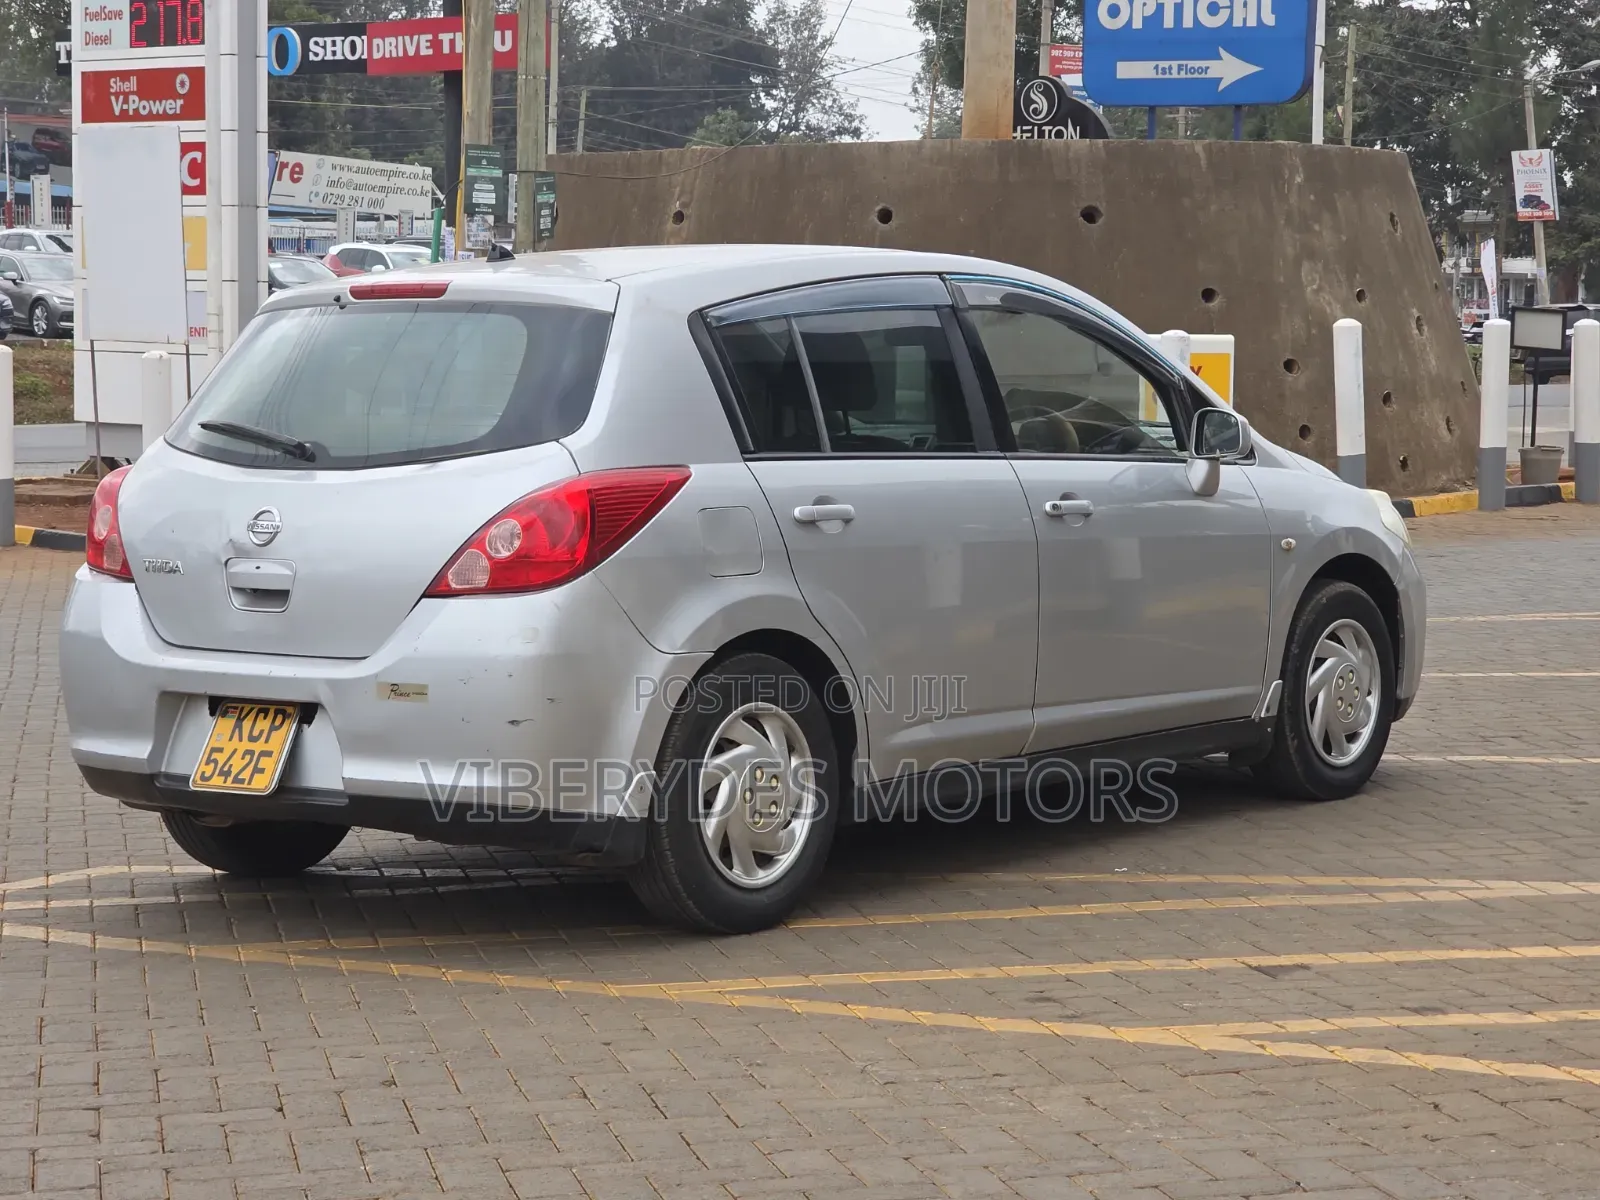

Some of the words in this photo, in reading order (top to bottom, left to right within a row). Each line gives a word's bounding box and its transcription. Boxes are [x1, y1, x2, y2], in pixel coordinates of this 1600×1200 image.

[84, 8, 123, 22] FuelSave
[1097, 0, 1276, 30] OPTICAL
[84, 30, 112, 46] Diesel
[372, 35, 432, 59] DRIVE
[438, 30, 513, 54] TU
[1153, 64, 1173, 76] 1st
[1177, 63, 1210, 75] Floor
[110, 76, 137, 92] Shell
[111, 95, 184, 116] V-Power
[331, 162, 432, 182] www.autoempire.co.ke
[1516, 168, 1547, 176] PHOENIX
[326, 176, 430, 198] info@autoempire.co.ke
[322, 192, 345, 206] 0729
[347, 195, 364, 208] 281
[367, 197, 385, 210] 000
[250, 521, 277, 531] NISSAN
[143, 558, 184, 575] TIIDA
[228, 706, 288, 744] KCP
[200, 747, 274, 786] 542F
